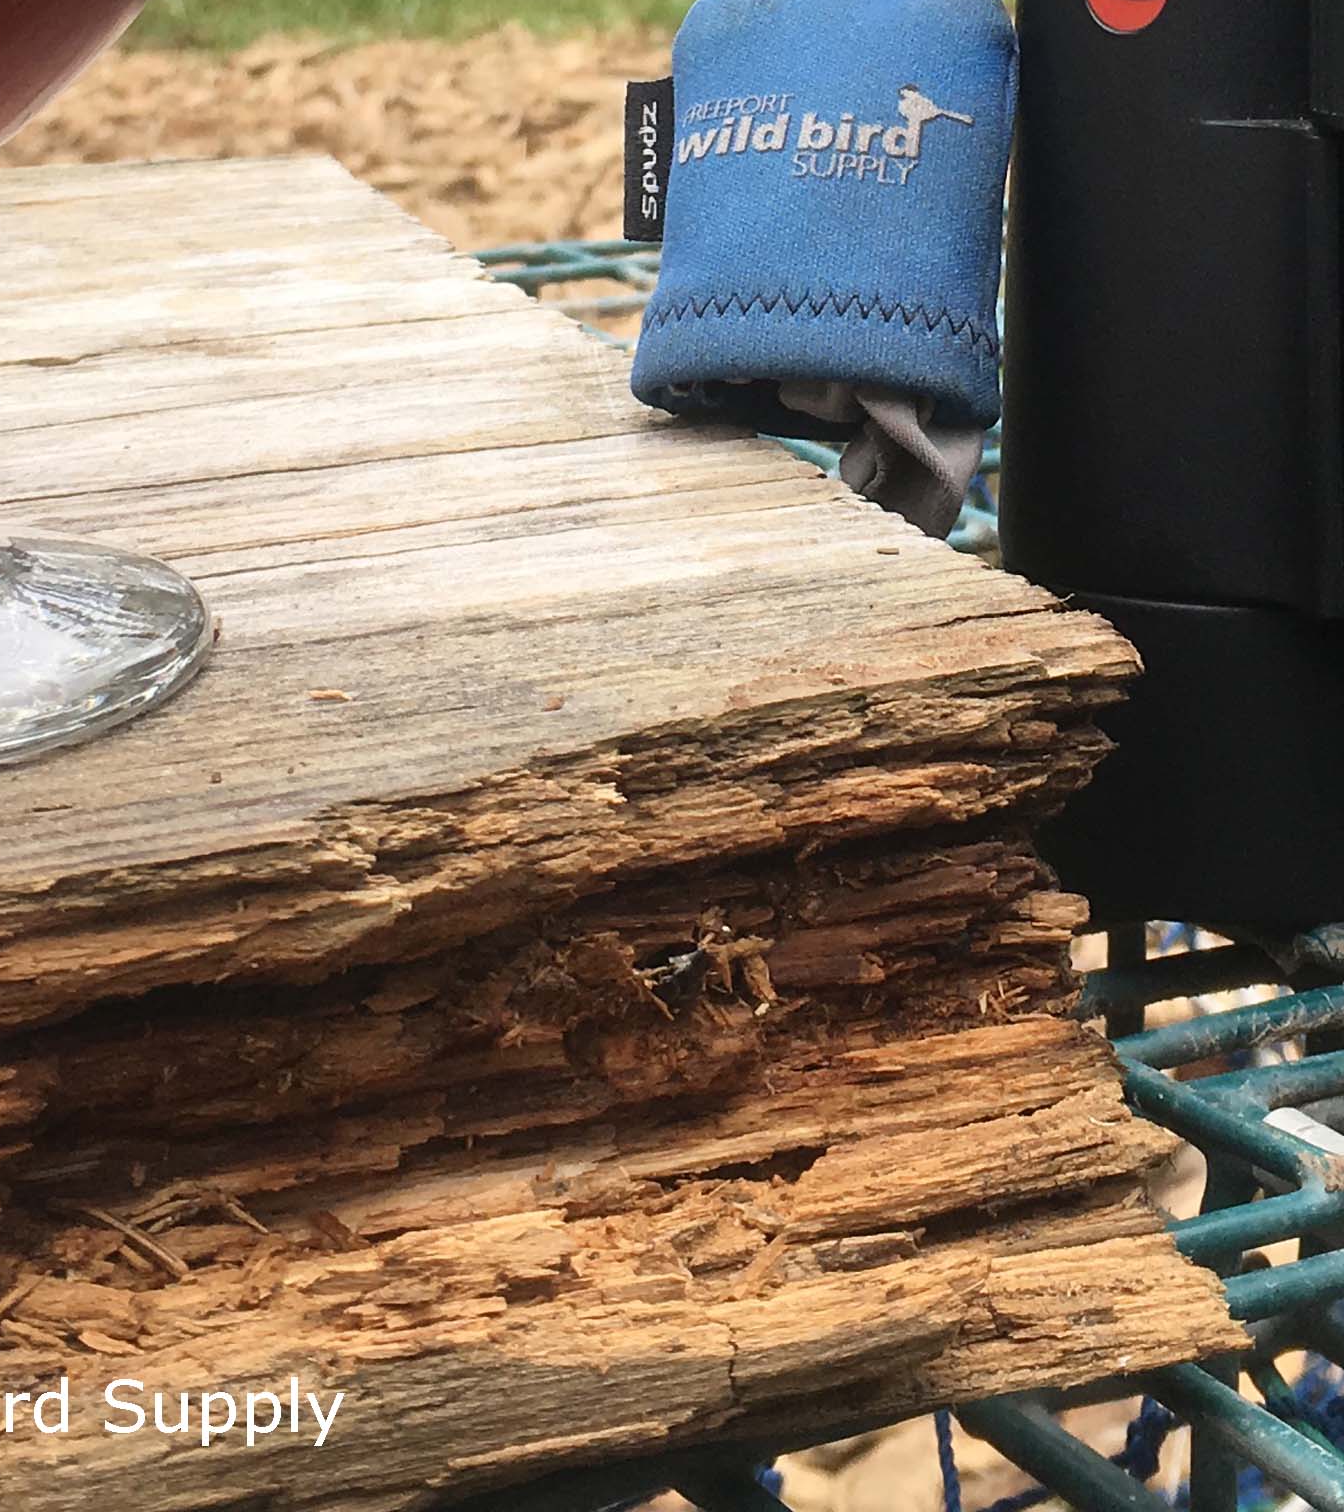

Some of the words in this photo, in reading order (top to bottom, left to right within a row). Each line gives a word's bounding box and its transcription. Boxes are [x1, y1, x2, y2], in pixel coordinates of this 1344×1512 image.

[682, 93, 795, 128] FREEPORT
[677, 112, 790, 165] wild
[796, 111, 923, 159] bird
[791, 152, 920, 186] SUPPLY
